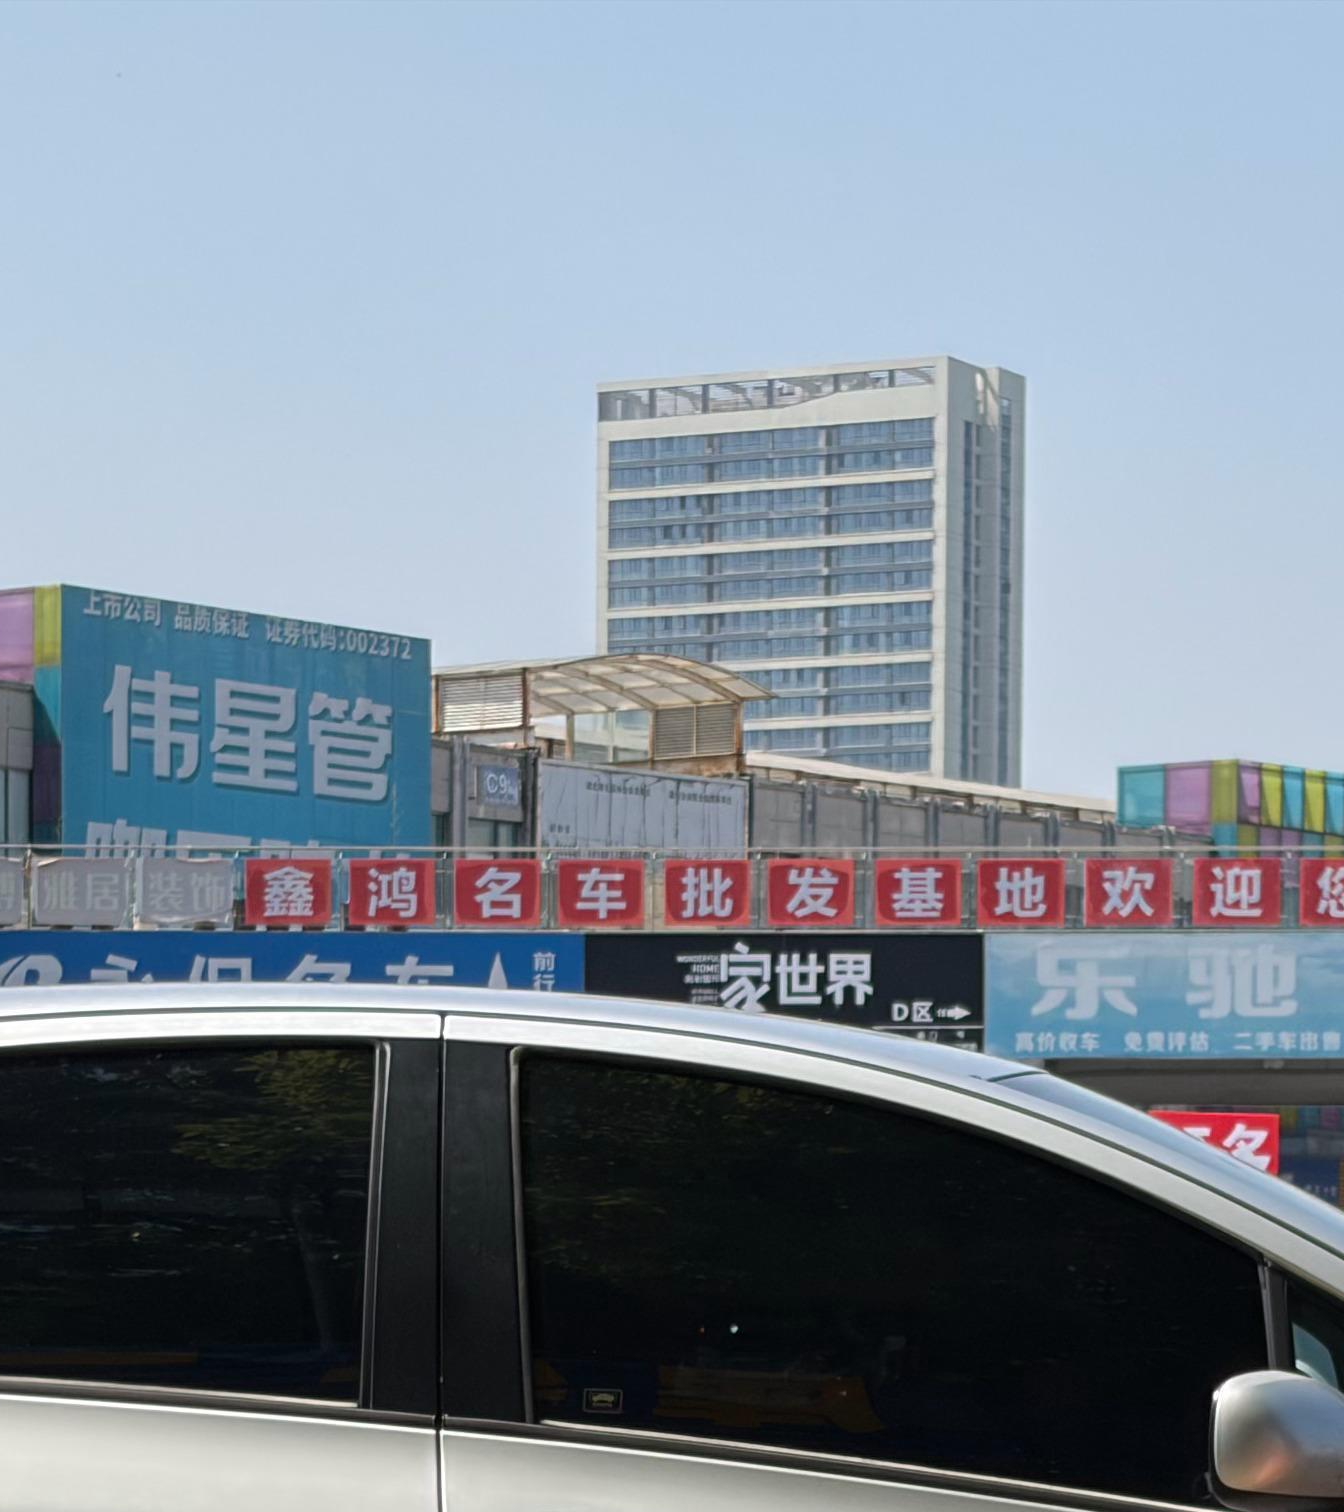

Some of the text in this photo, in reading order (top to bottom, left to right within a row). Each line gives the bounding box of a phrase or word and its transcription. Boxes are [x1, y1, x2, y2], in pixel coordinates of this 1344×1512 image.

[83, 590, 413, 661] 上市公司 品质保证 证券代码:002372
[103, 665, 393, 801] 伟星管
[719, 942, 873, 1012] 家世界
[1015, 1031, 1101, 1052] 高价收车
[1124, 1030, 1209, 1052] 免费评估
[1233, 1031, 1342, 1052] 二手车出售
